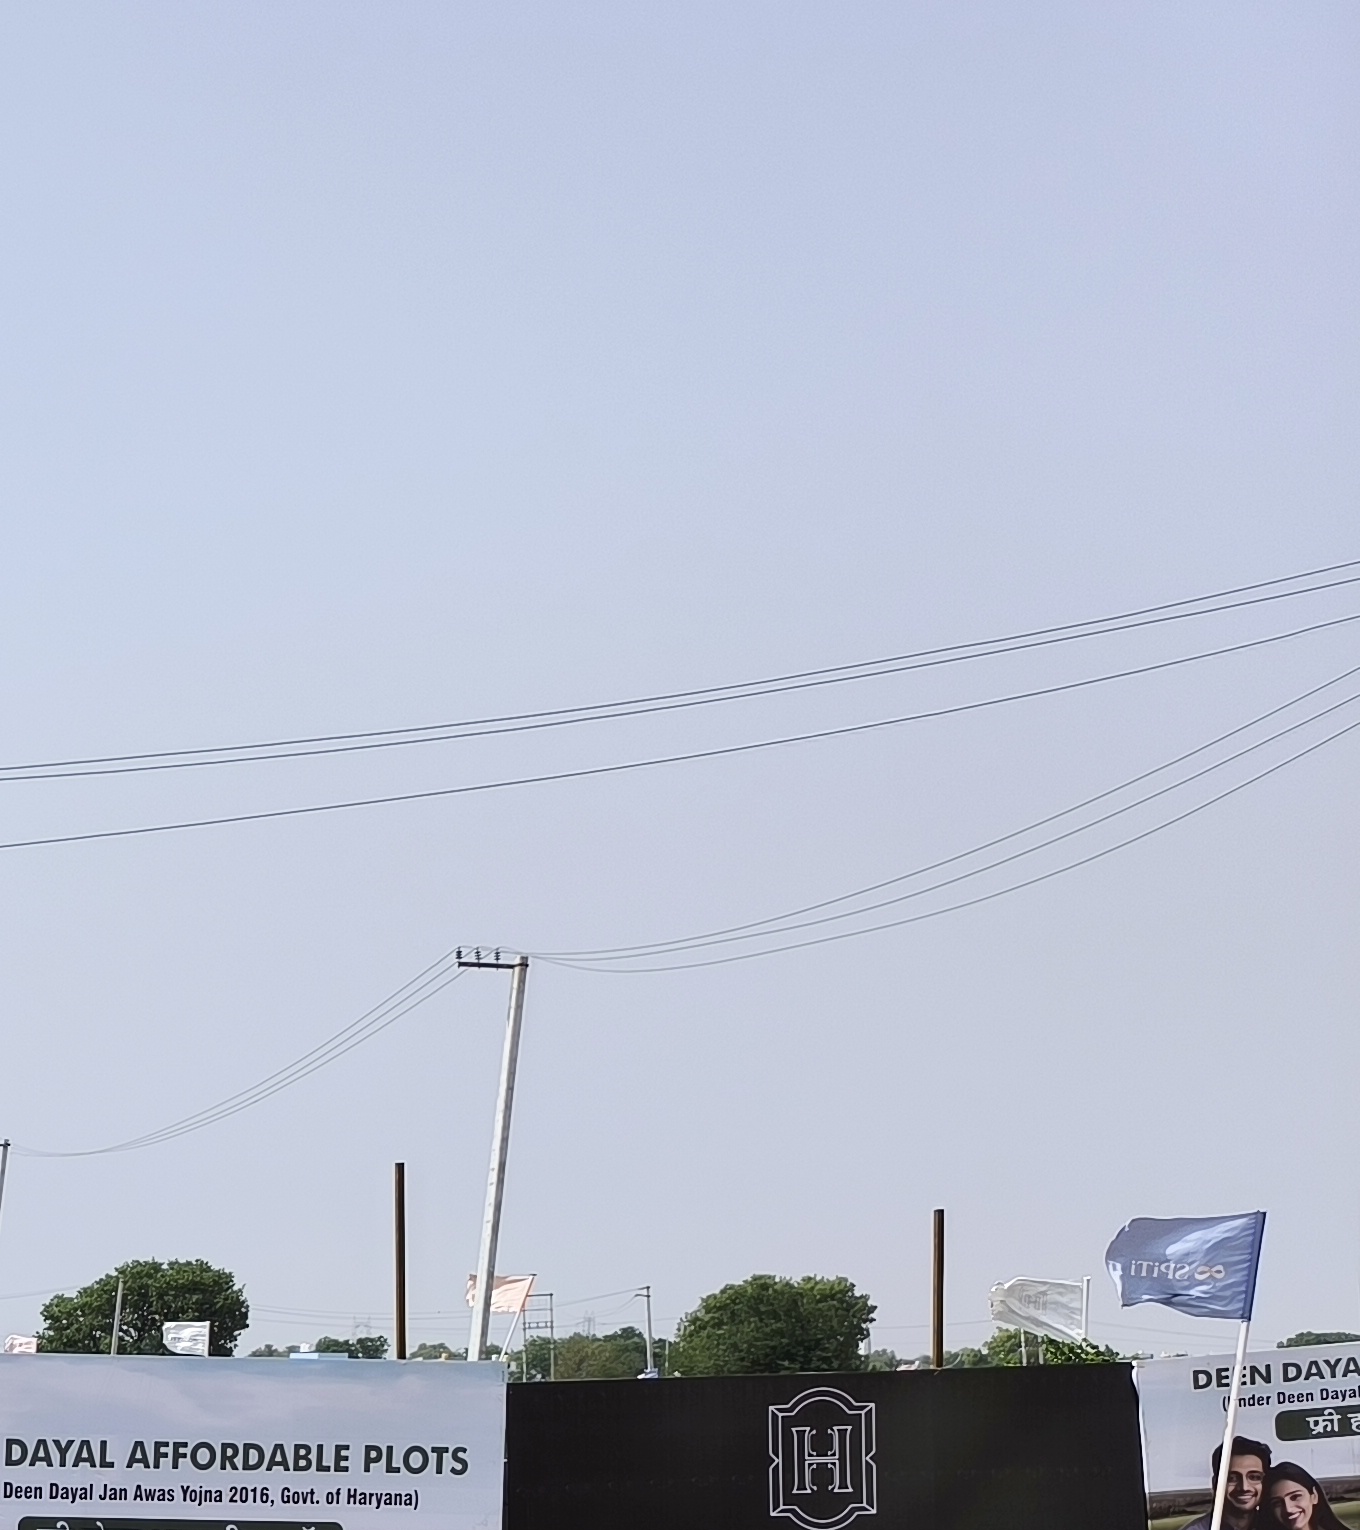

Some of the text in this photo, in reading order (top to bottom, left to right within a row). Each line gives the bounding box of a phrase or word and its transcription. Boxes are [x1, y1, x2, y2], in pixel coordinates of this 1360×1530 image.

[1277, 1390, 1314, 1405] Deen
[1305, 1409, 1342, 1435] फ्री
[4, 1438, 115, 1469] DAYAL
[126, 1440, 350, 1473] AFFORDABLE
[363, 1444, 469, 1476] PLOTS
[3, 1482, 43, 1500] Deen
[49, 1483, 93, 1504] Dayal
[98, 1483, 128, 1501] Jan
[133, 1484, 175, 1502] Awas
[180, 1485, 223, 1506] Yojna
[228, 1486, 275, 1507] 2016,
[280, 1487, 320, 1505] Govt.
[325, 1487, 341, 1505] of
[346, 1487, 419, 1510] Haryana)
